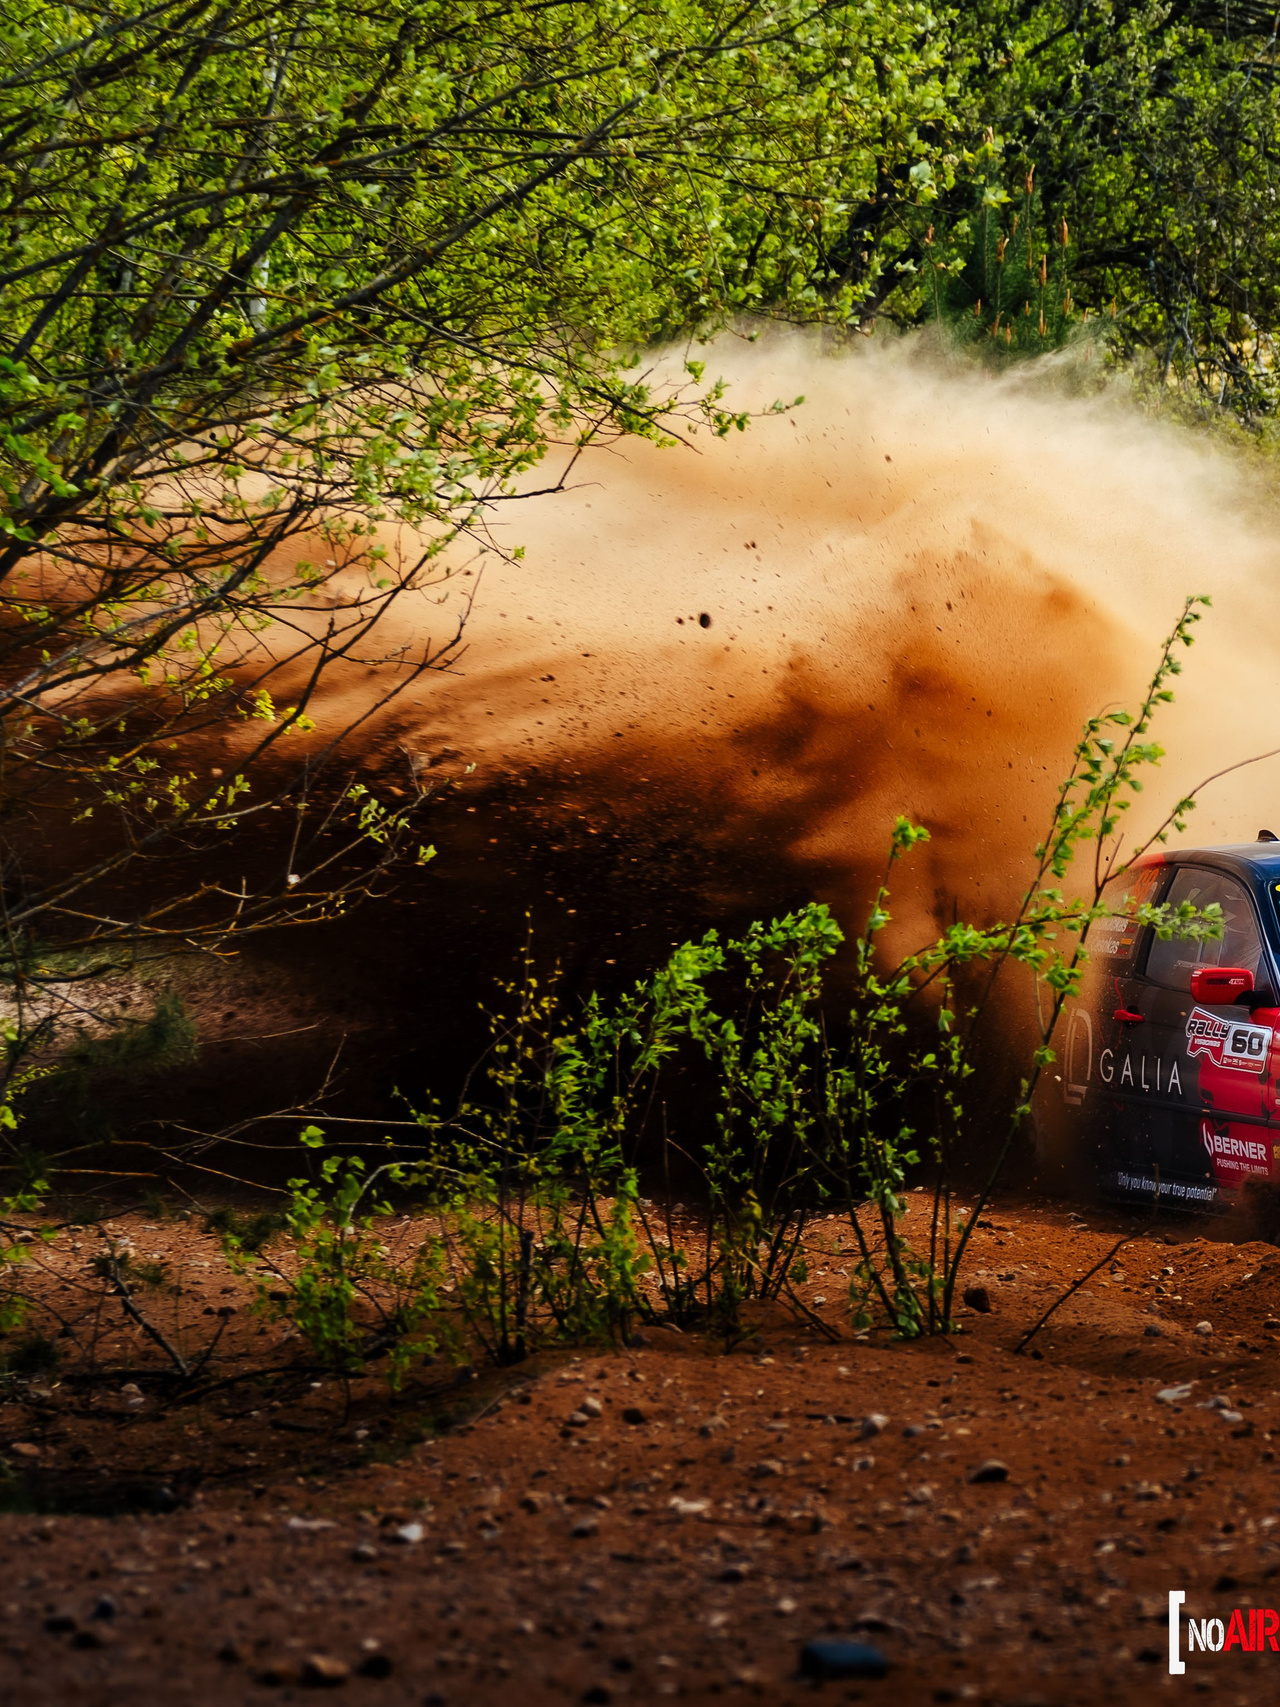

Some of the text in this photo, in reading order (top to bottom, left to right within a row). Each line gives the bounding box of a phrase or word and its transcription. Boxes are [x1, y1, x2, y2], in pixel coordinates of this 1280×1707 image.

[1231, 1029, 1265, 1056] 60
[1100, 1048, 1182, 1095] GALIA
[1214, 1135, 1267, 1161] BERNER
[1217, 1157, 1269, 1176] PUSHING THE LIMITS
[1129, 1177, 1141, 1190] you
[1141, 1176, 1157, 1192] know
[1157, 1181, 1172, 1194] your
[1172, 1183, 1186, 1196] true
